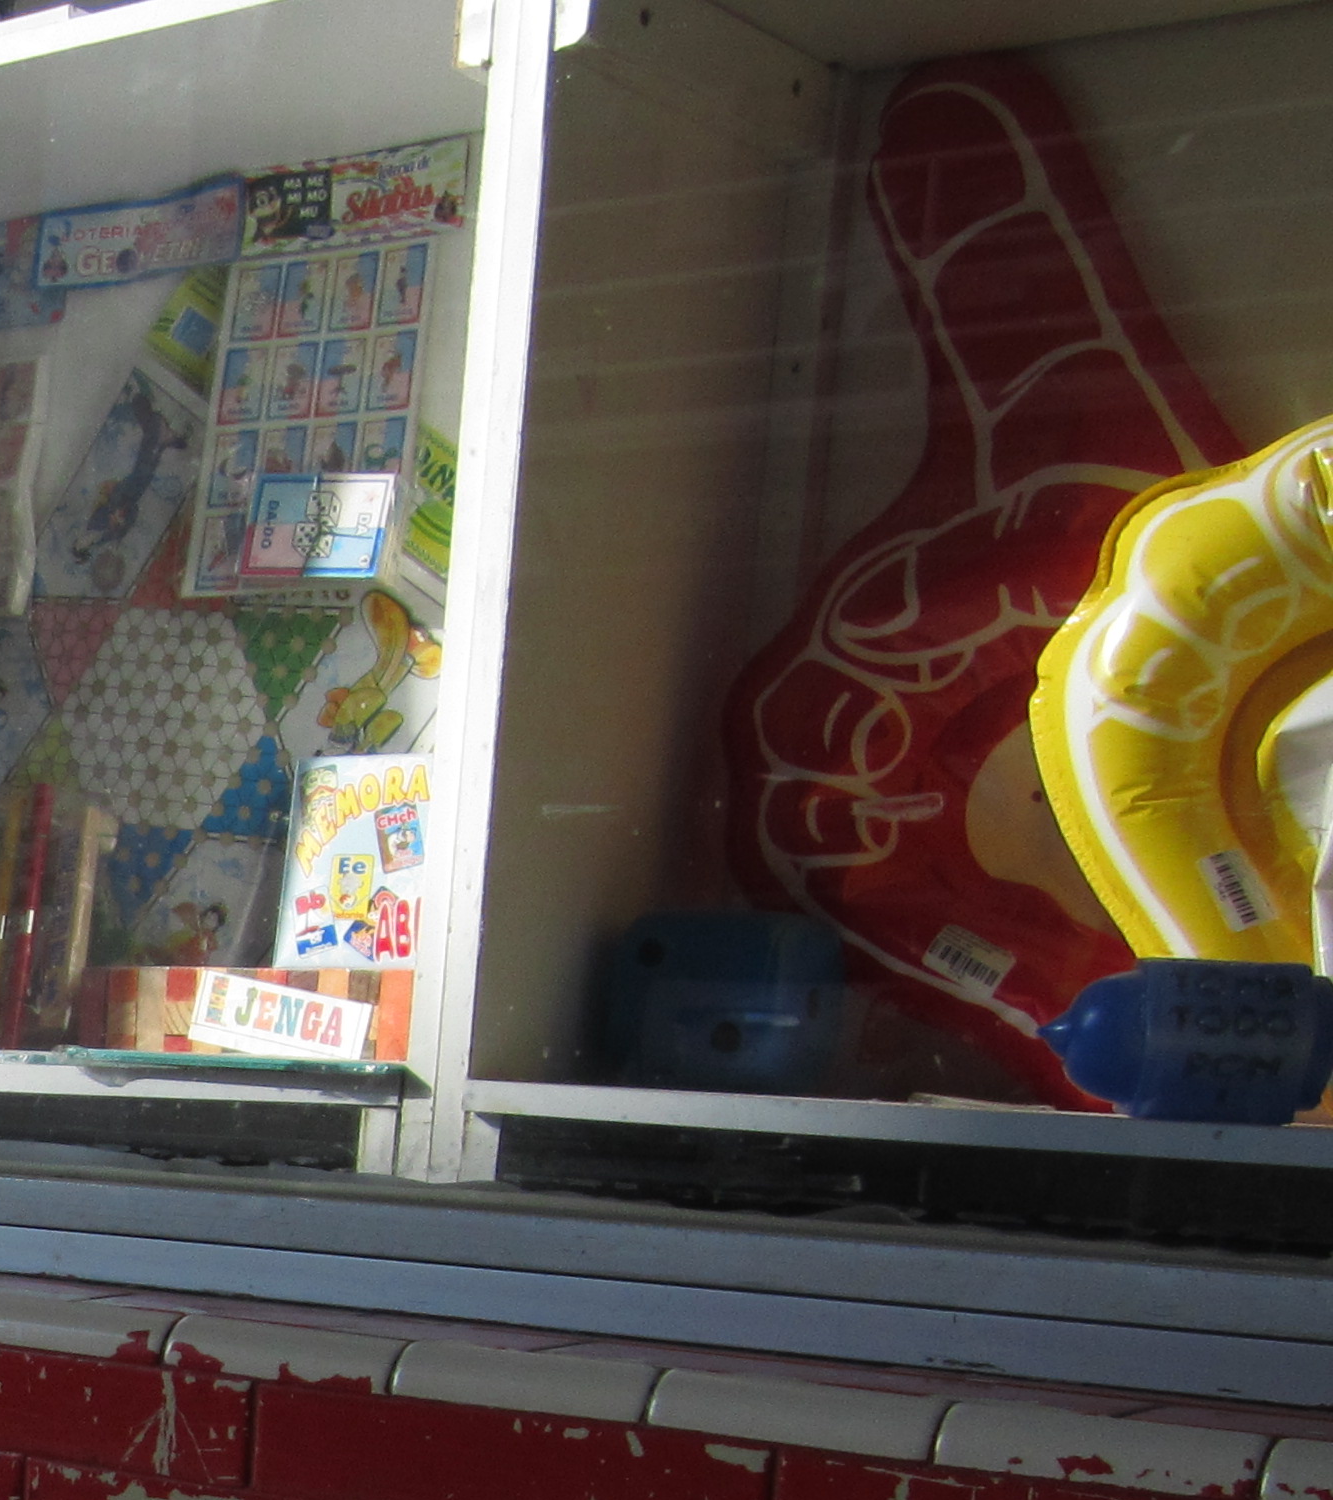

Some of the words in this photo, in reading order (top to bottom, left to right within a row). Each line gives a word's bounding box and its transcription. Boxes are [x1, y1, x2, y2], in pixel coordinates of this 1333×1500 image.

[283, 177, 302, 190] MA
[305, 174, 325, 187] ME
[286, 191, 302, 204] MI
[306, 188, 328, 202] MO
[299, 205, 319, 218] MU
[261, 500, 280, 549] DA-DO
[338, 856, 367, 876] Ee
[295, 890, 327, 915] Bb
[375, 897, 423, 961] AB
[234, 986, 344, 1048] JENGA
